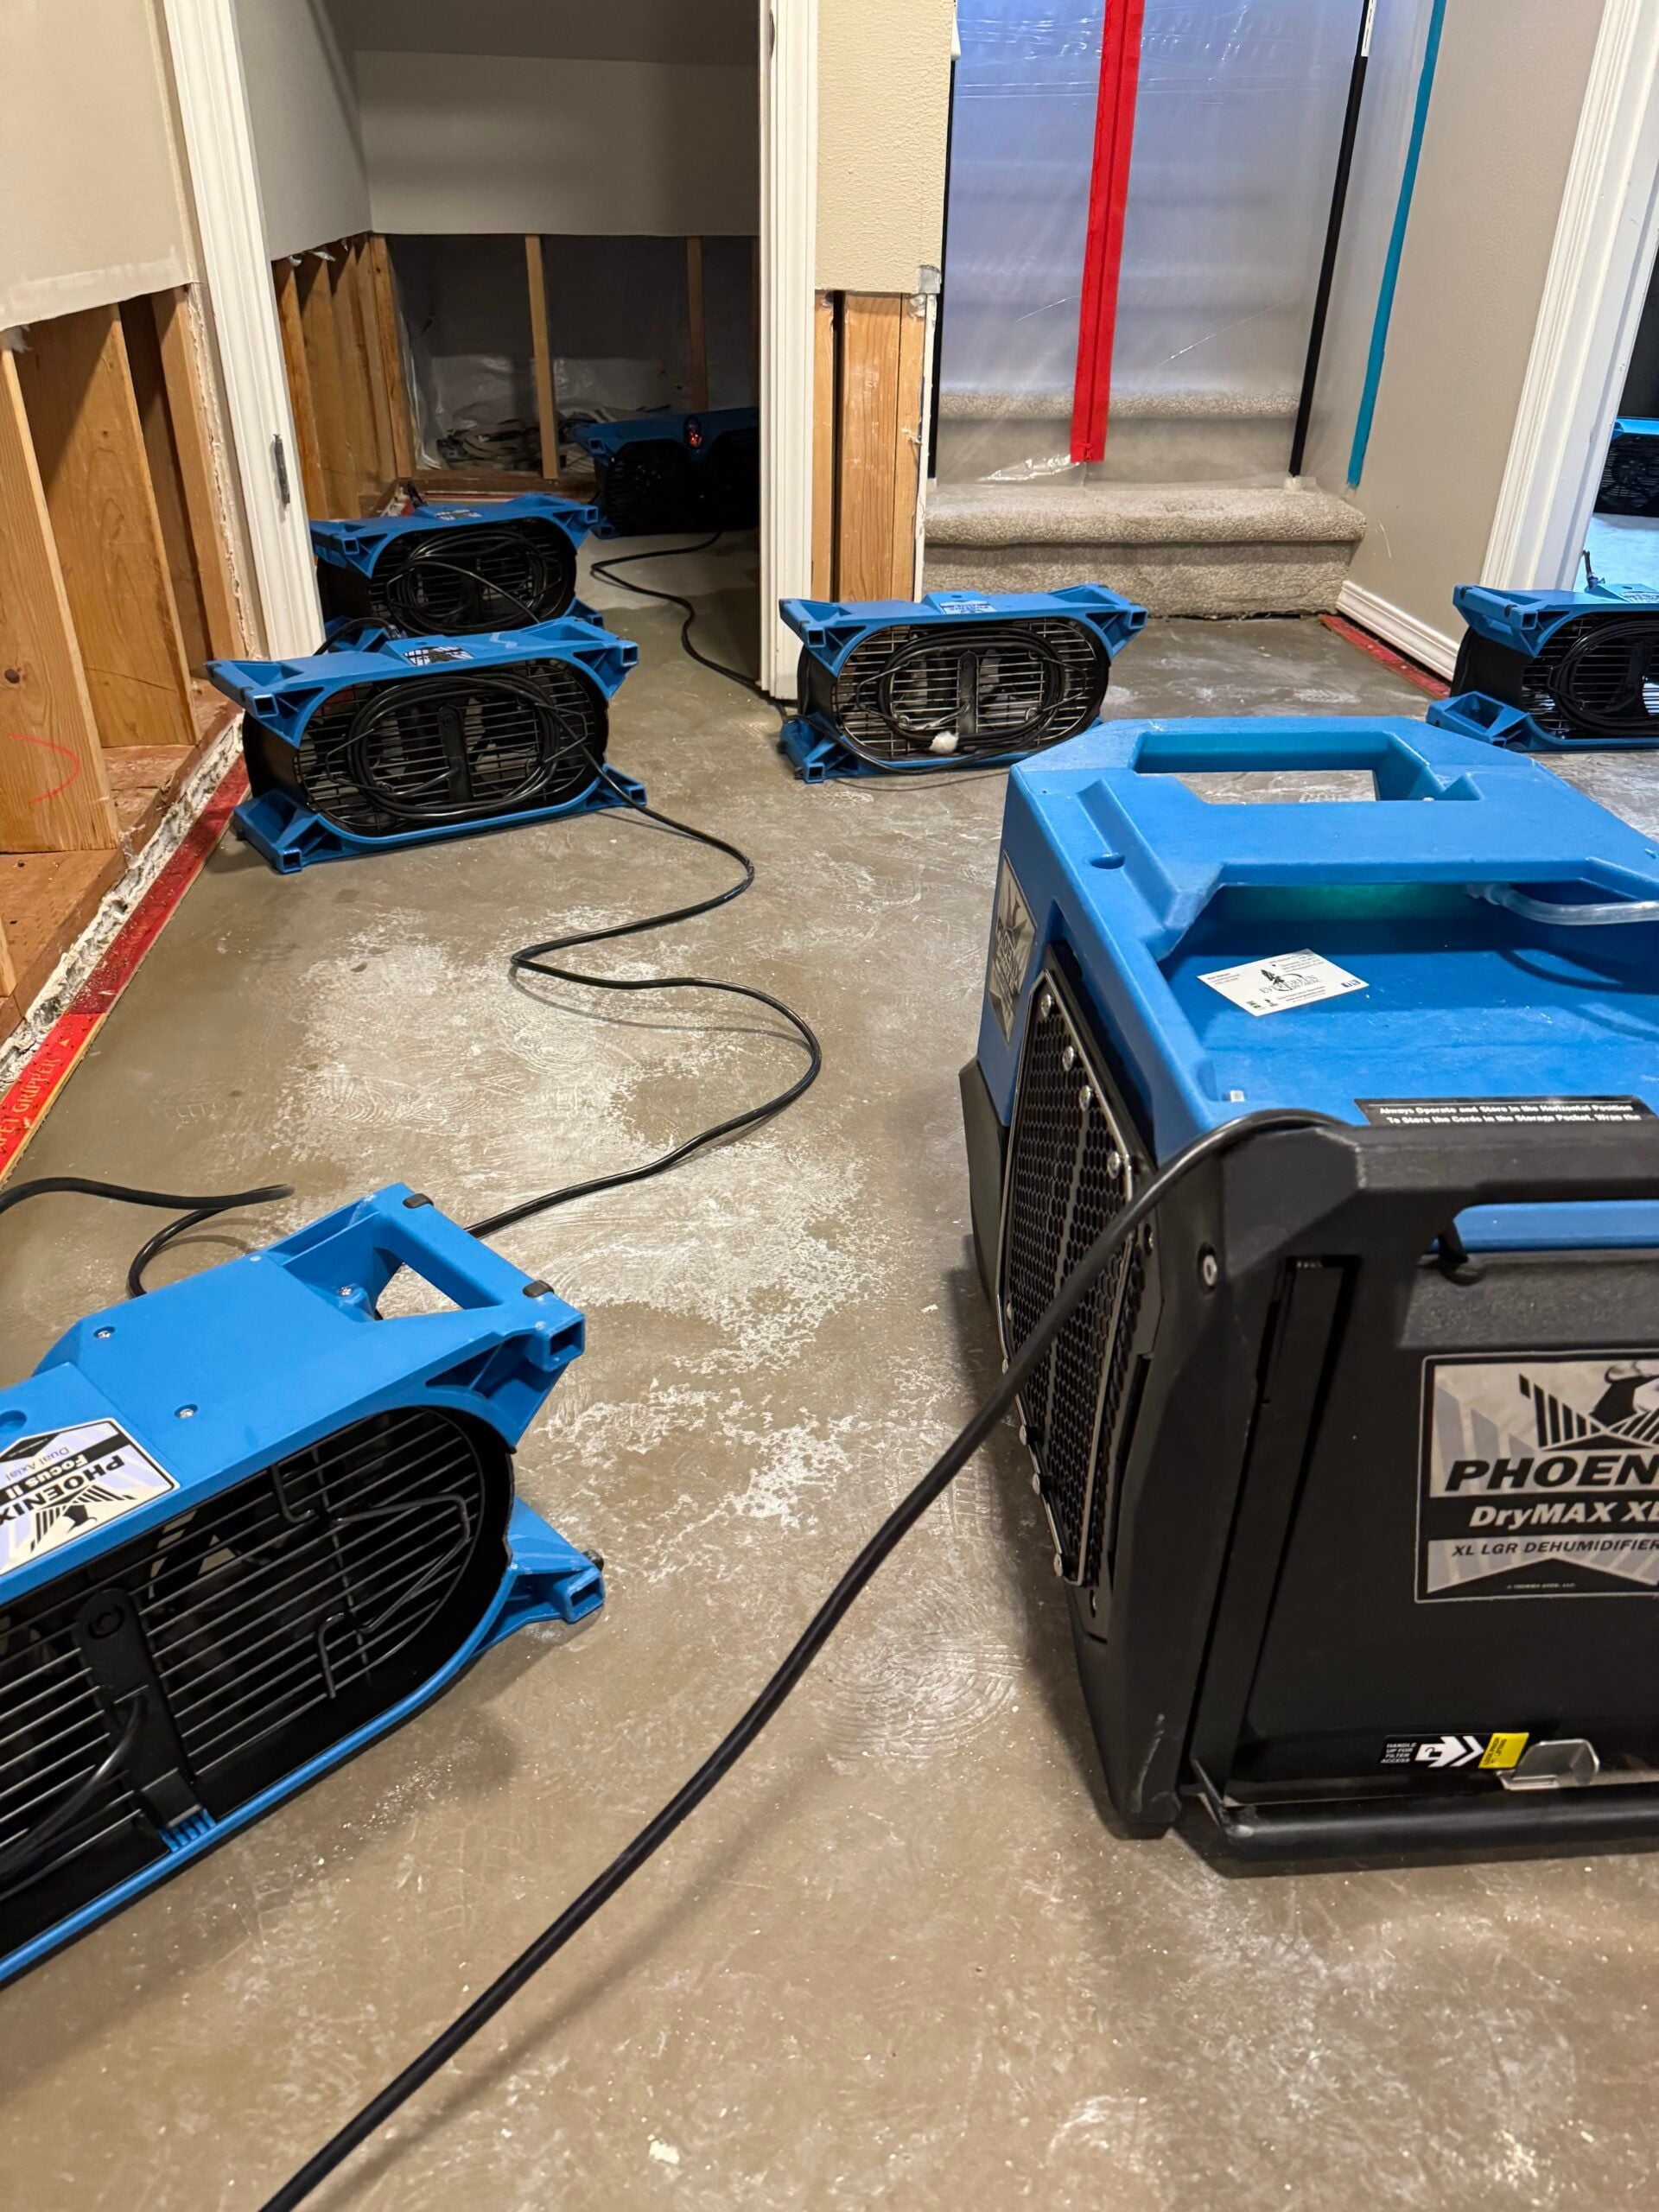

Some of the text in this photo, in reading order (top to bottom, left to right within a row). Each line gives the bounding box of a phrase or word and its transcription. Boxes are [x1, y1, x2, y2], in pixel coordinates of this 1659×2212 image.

[12, 1058, 61, 1114] GRIPPER
[1380, 1107, 1414, 1116] Always
[1415, 1106, 1457, 1115] Operate
[38, 1446, 70, 1465] Dual
[5, 1463, 36, 1481] Axial
[1445, 1454, 1659, 1491] PHOEN
[0, 1455, 125, 1526] PHOENIX
[5, 1484, 24, 1499] II
[1469, 1501, 1618, 1530] DryMAX
[1452, 1538, 1659, 1556] XL LGR DEHUMIDIFIER
